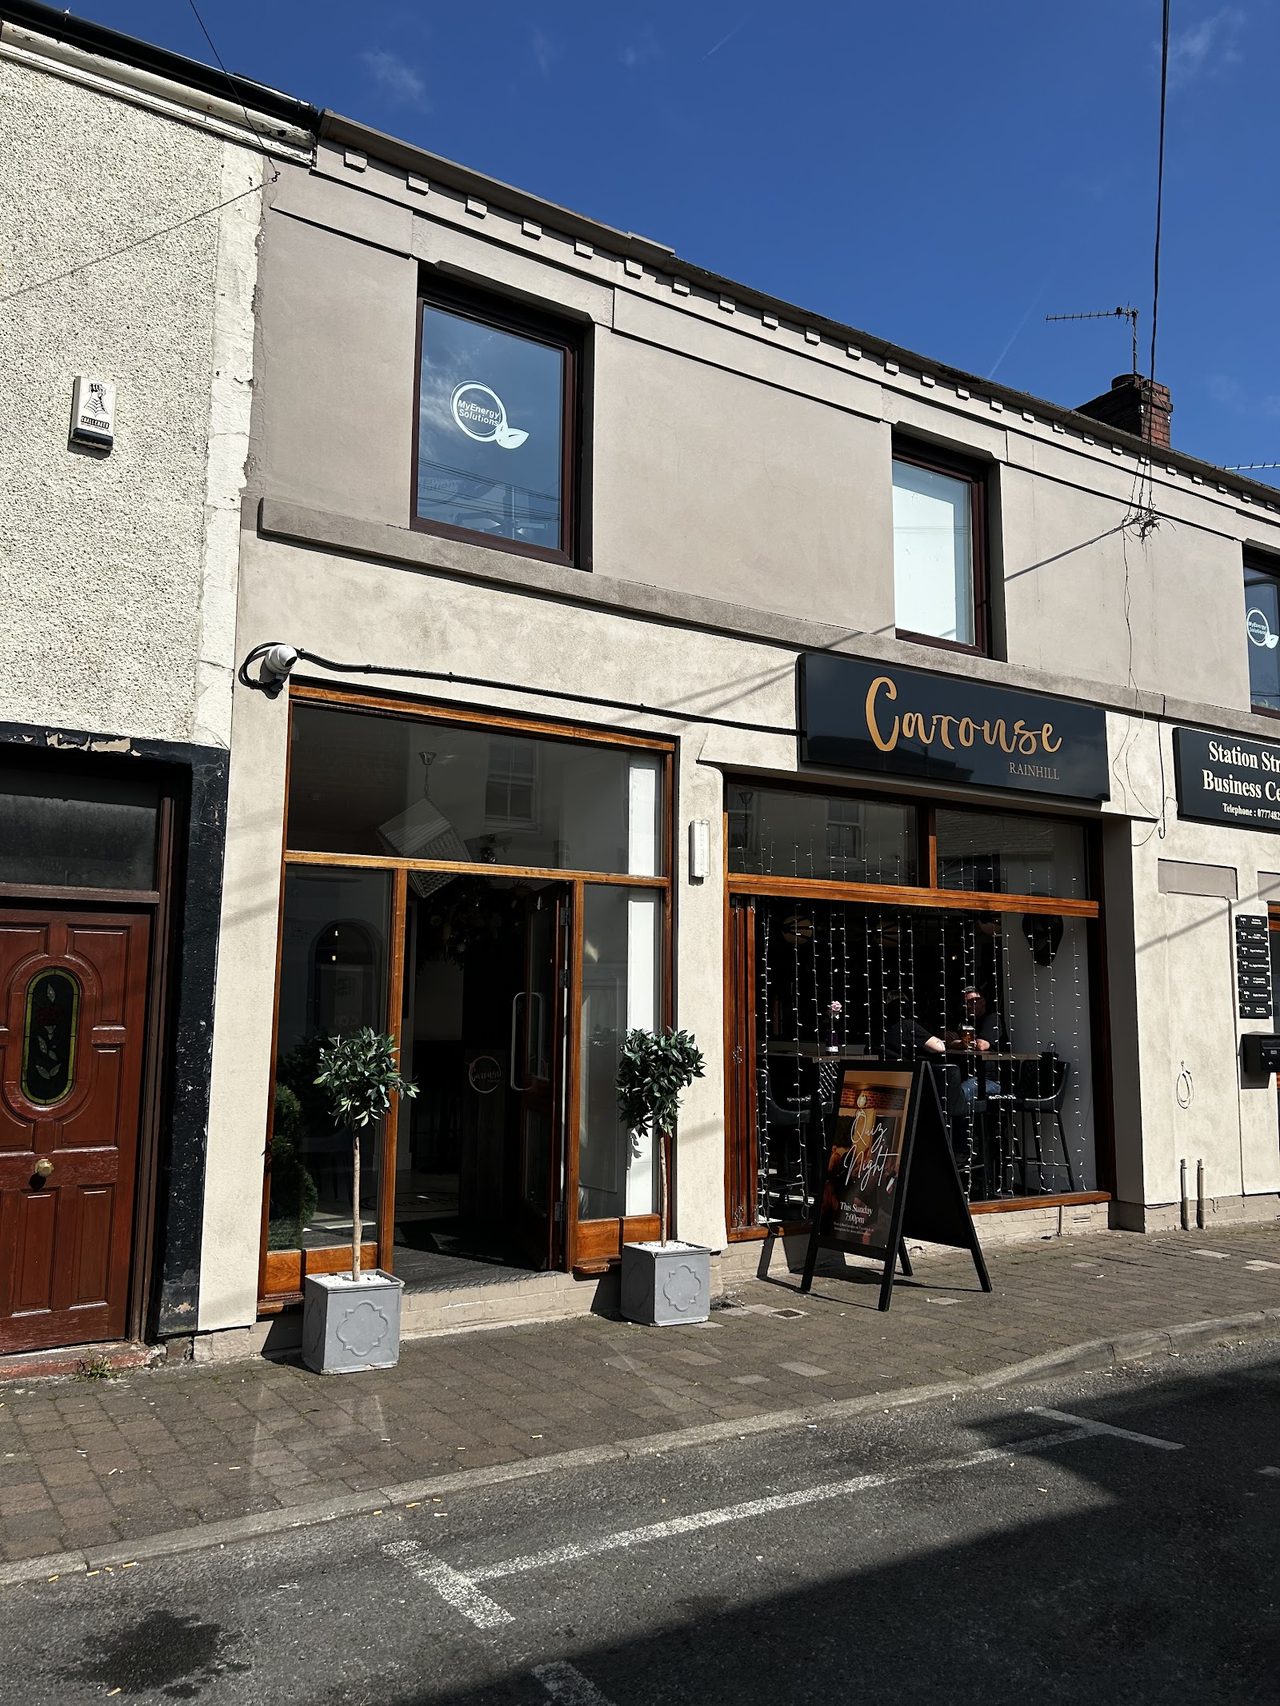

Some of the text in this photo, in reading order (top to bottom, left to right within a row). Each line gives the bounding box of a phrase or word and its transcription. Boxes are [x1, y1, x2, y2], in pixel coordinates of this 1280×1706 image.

[458, 400, 500, 419] MyEnergy
[459, 409, 498, 425] Solutions
[865, 676, 1063, 755] Carouse
[1209, 741, 1259, 768] Station
[1009, 762, 1060, 780] RAINHILL
[1202, 769, 1262, 798] Business
[1222, 803, 1253, 816] Telephone
[850, 1110, 888, 1153] Quiz
[843, 1144, 899, 1191] Night
[840, 1201, 873, 1217] This Sunday
[845, 1212, 865, 1225] 7:00pm
